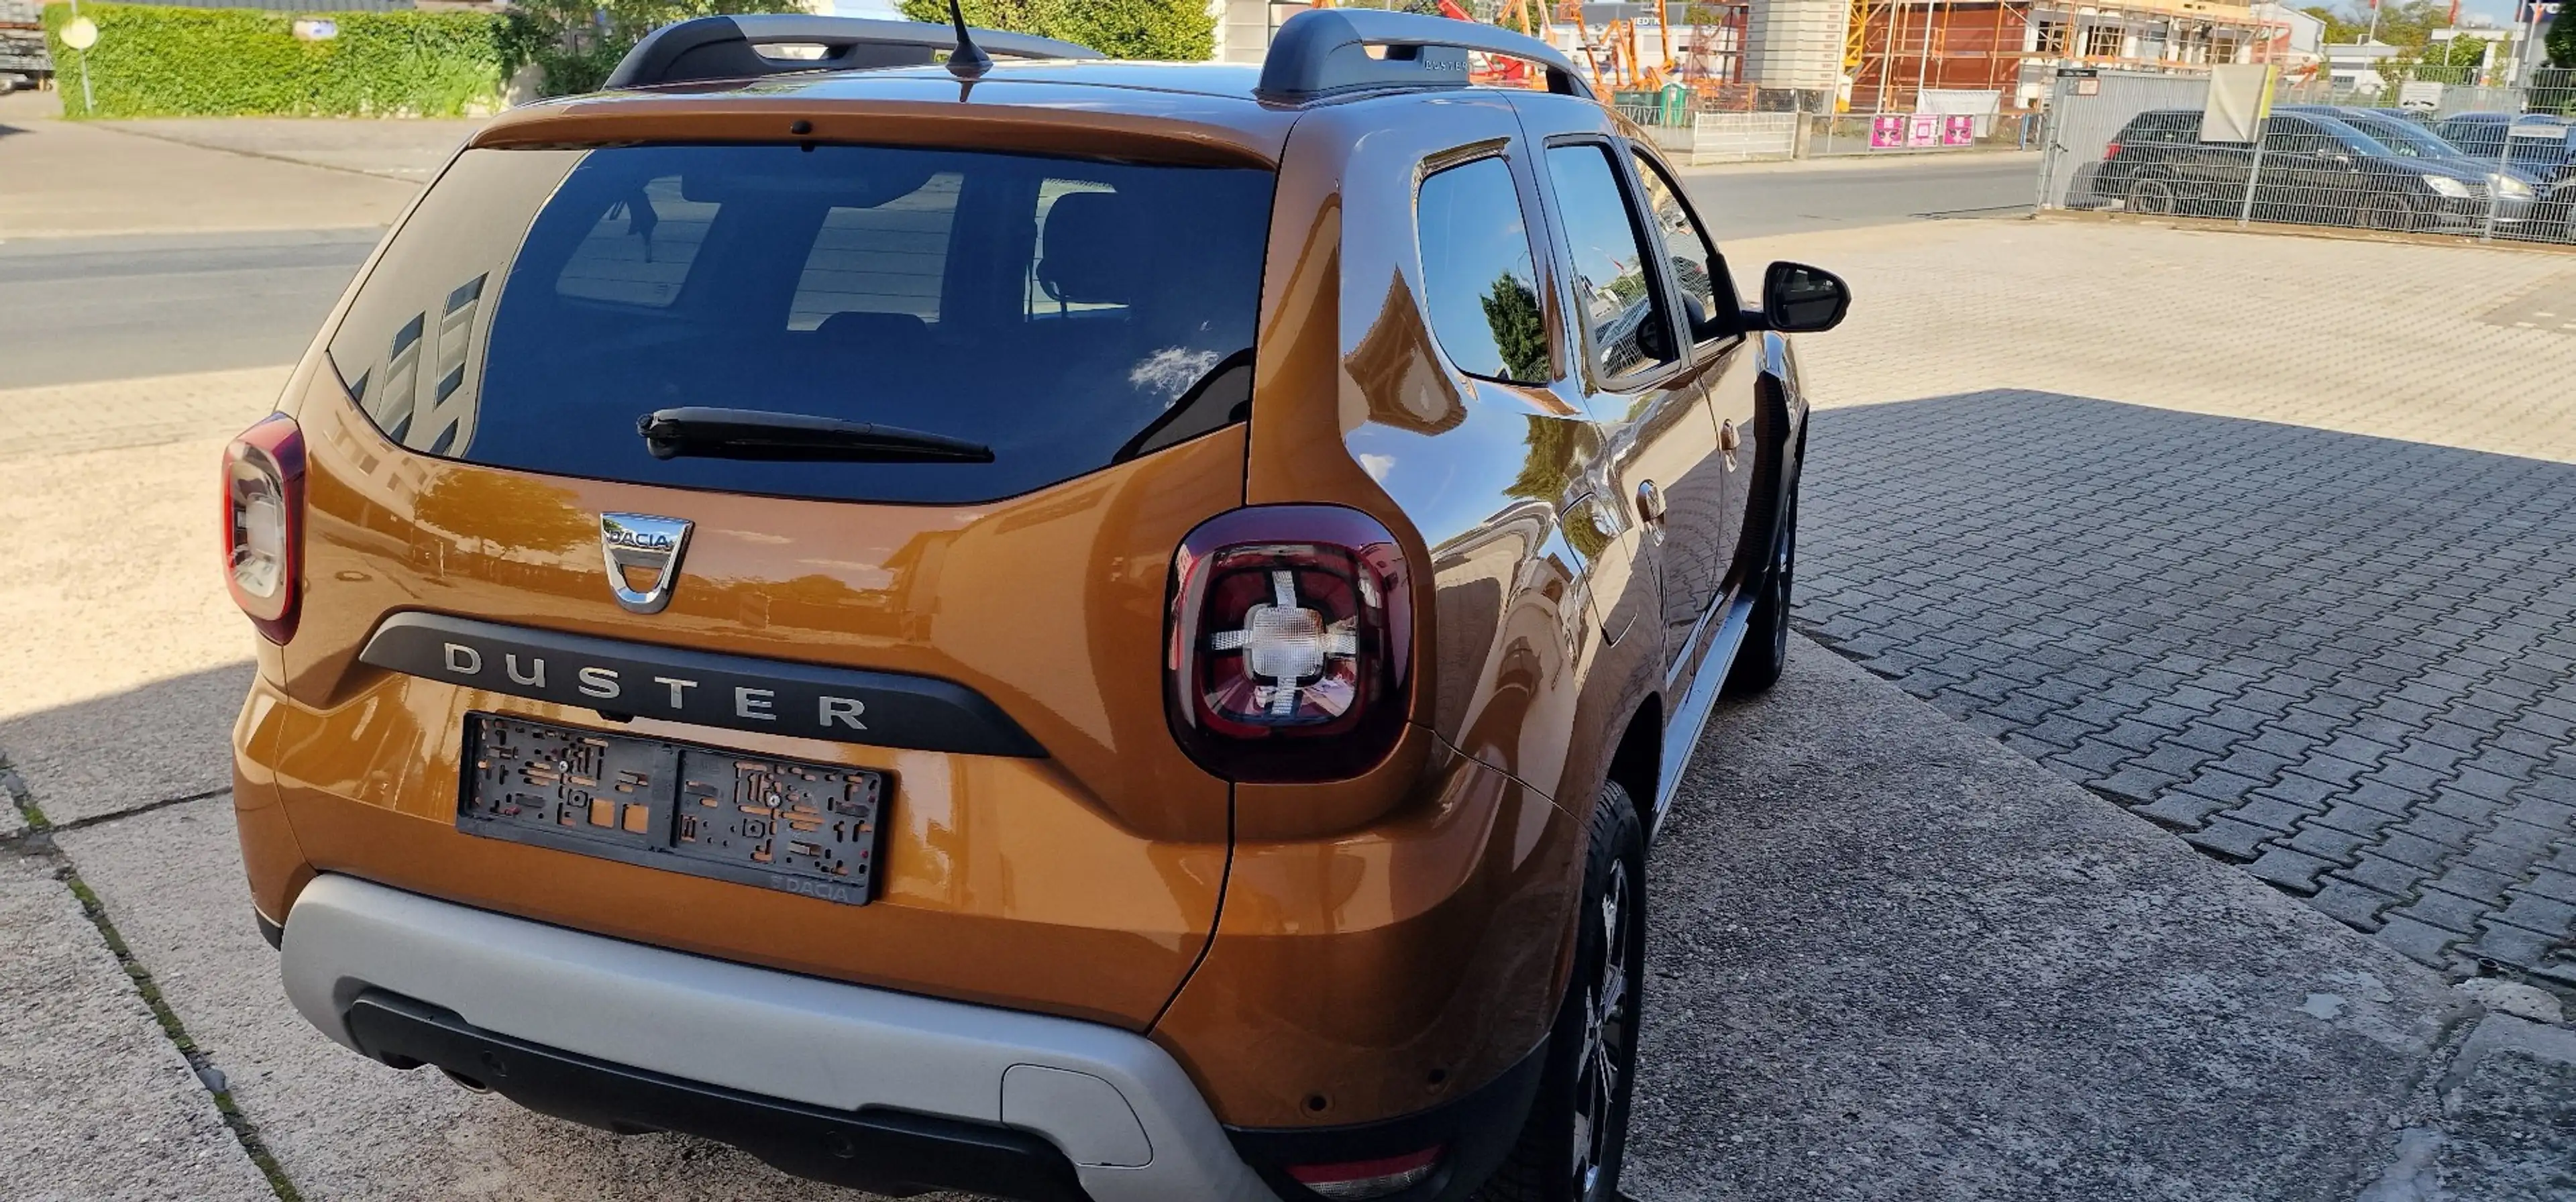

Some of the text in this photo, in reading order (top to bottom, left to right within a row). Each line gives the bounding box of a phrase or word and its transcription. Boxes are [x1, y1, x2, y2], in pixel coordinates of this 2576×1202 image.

[607, 530, 669, 547] DACIA
[444, 642, 867, 730] DUSTER
[786, 877, 849, 903] DACIA
